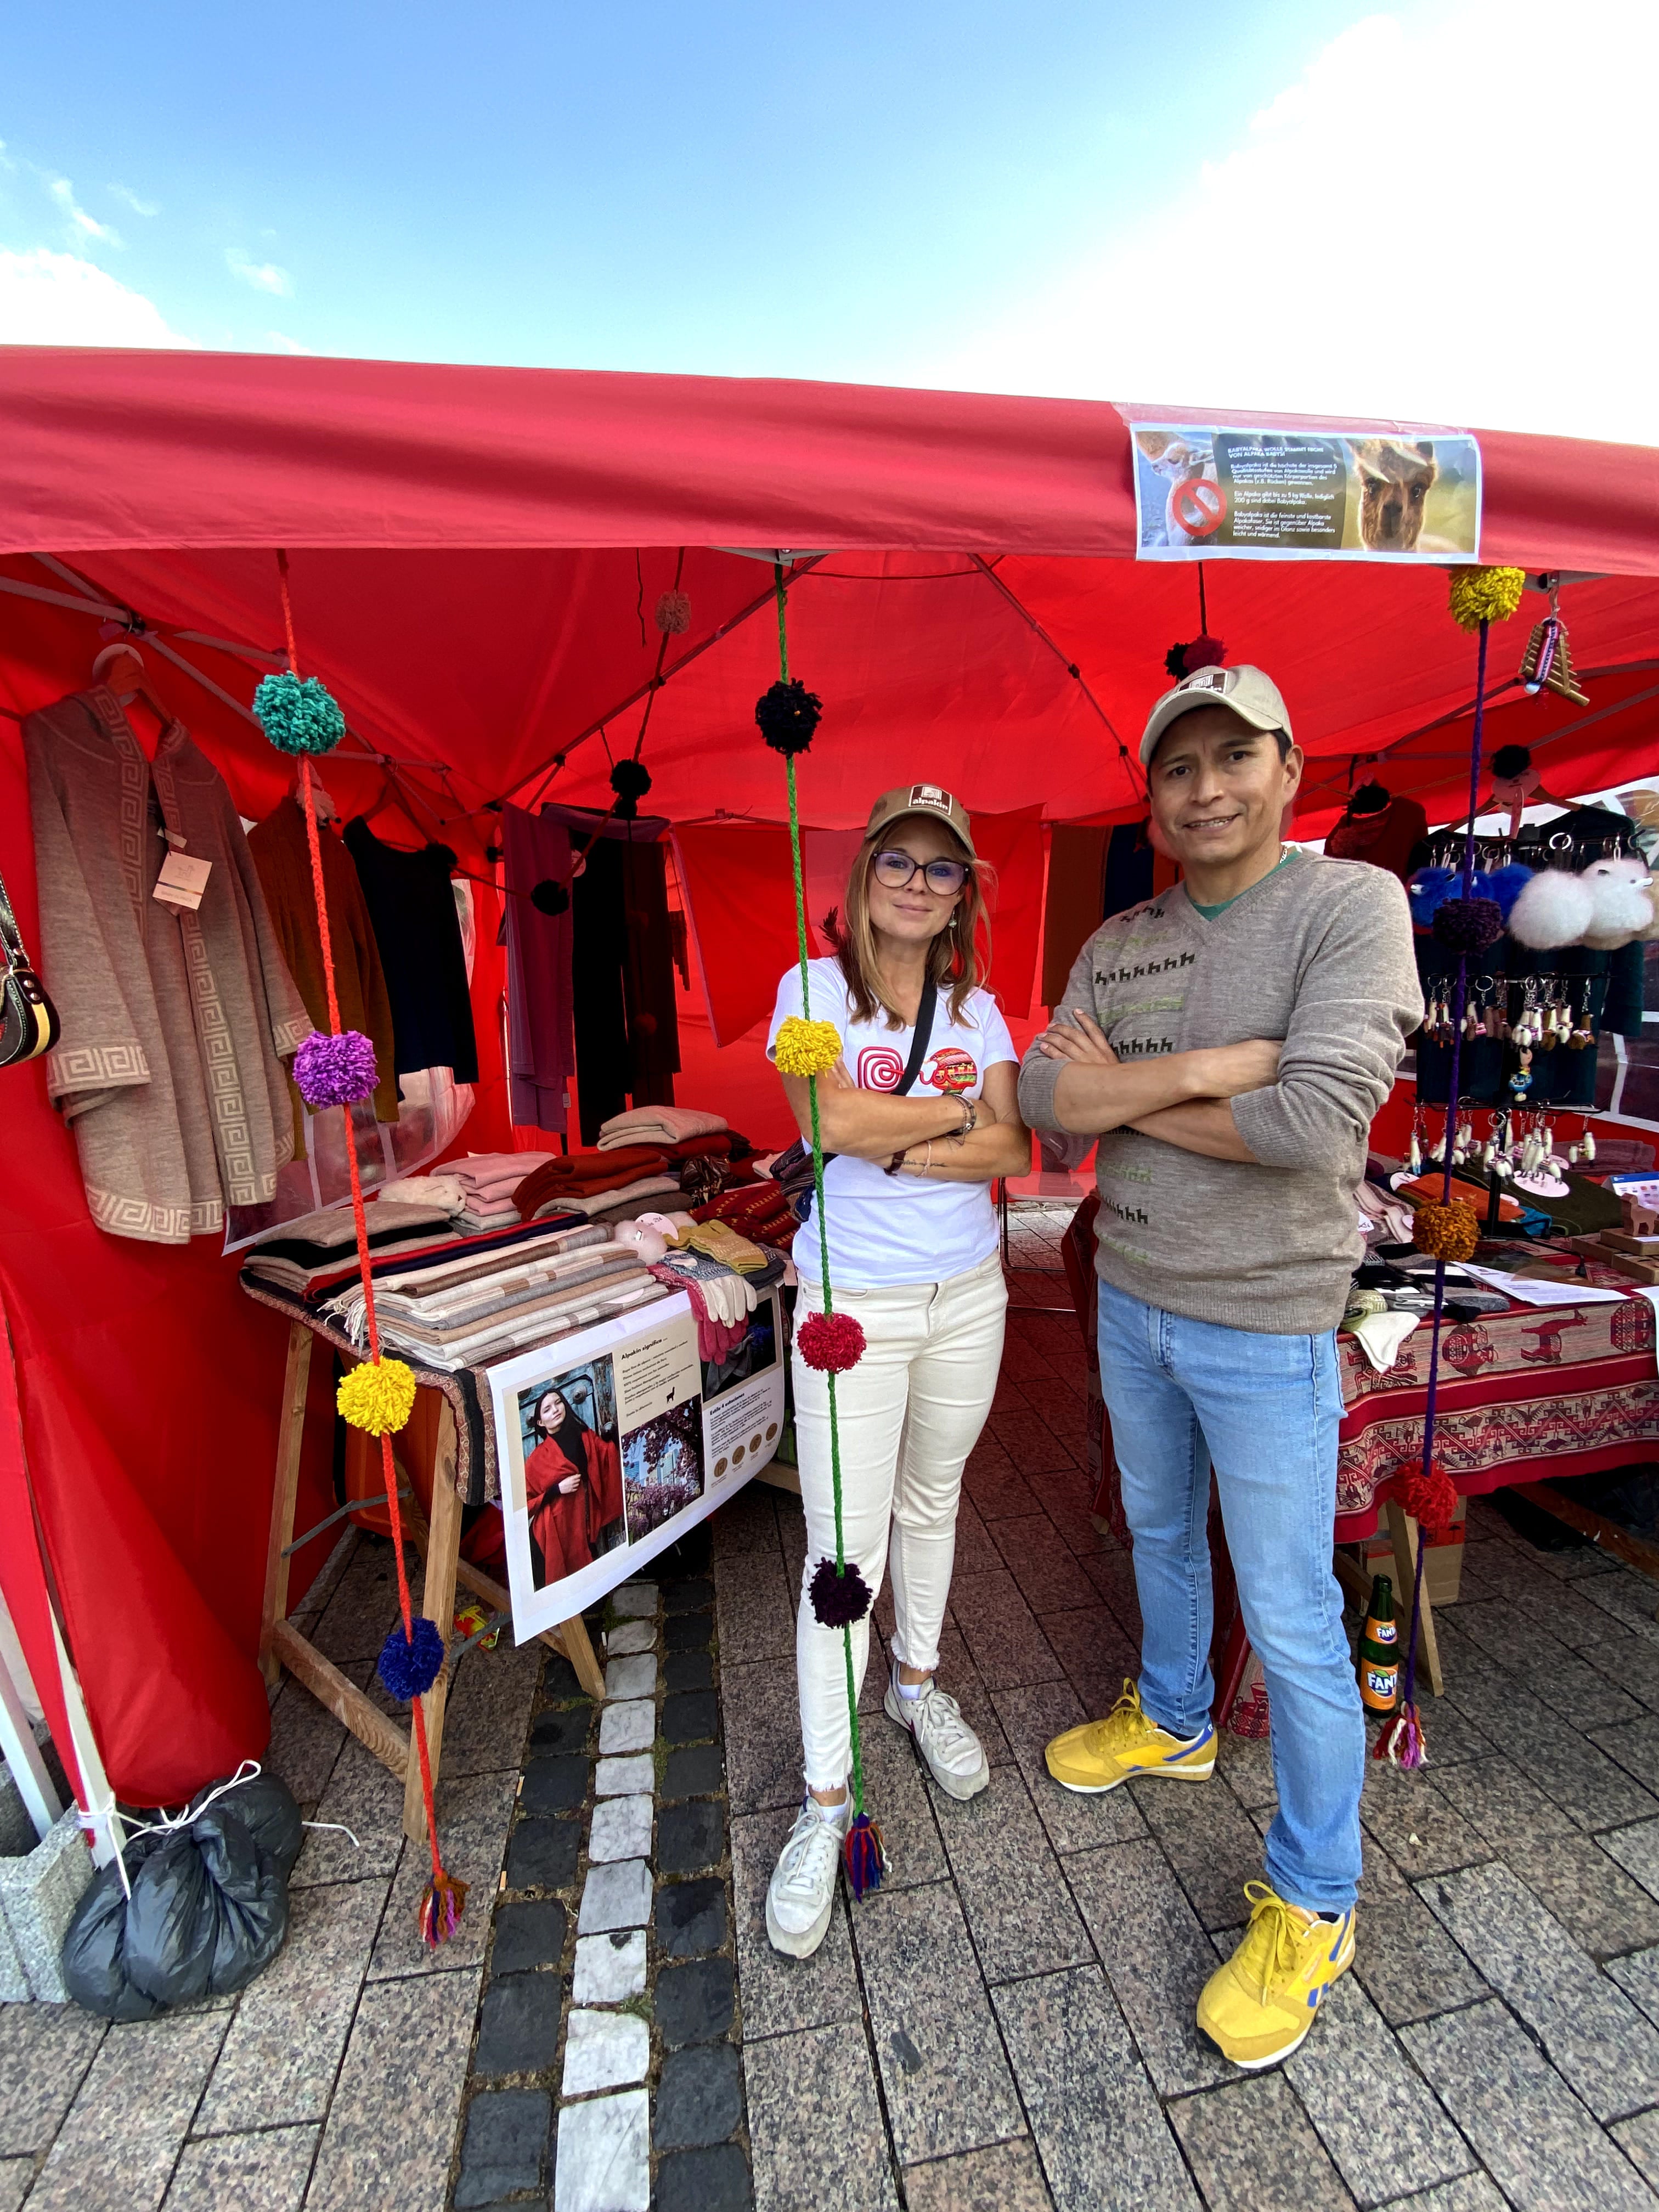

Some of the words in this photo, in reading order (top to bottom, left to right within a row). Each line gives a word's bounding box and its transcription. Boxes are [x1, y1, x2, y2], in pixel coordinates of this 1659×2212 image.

[912, 797, 948, 810] alpakin
[622, 1348, 641, 1360] Alpakin
[642, 1339, 662, 1351] significa
